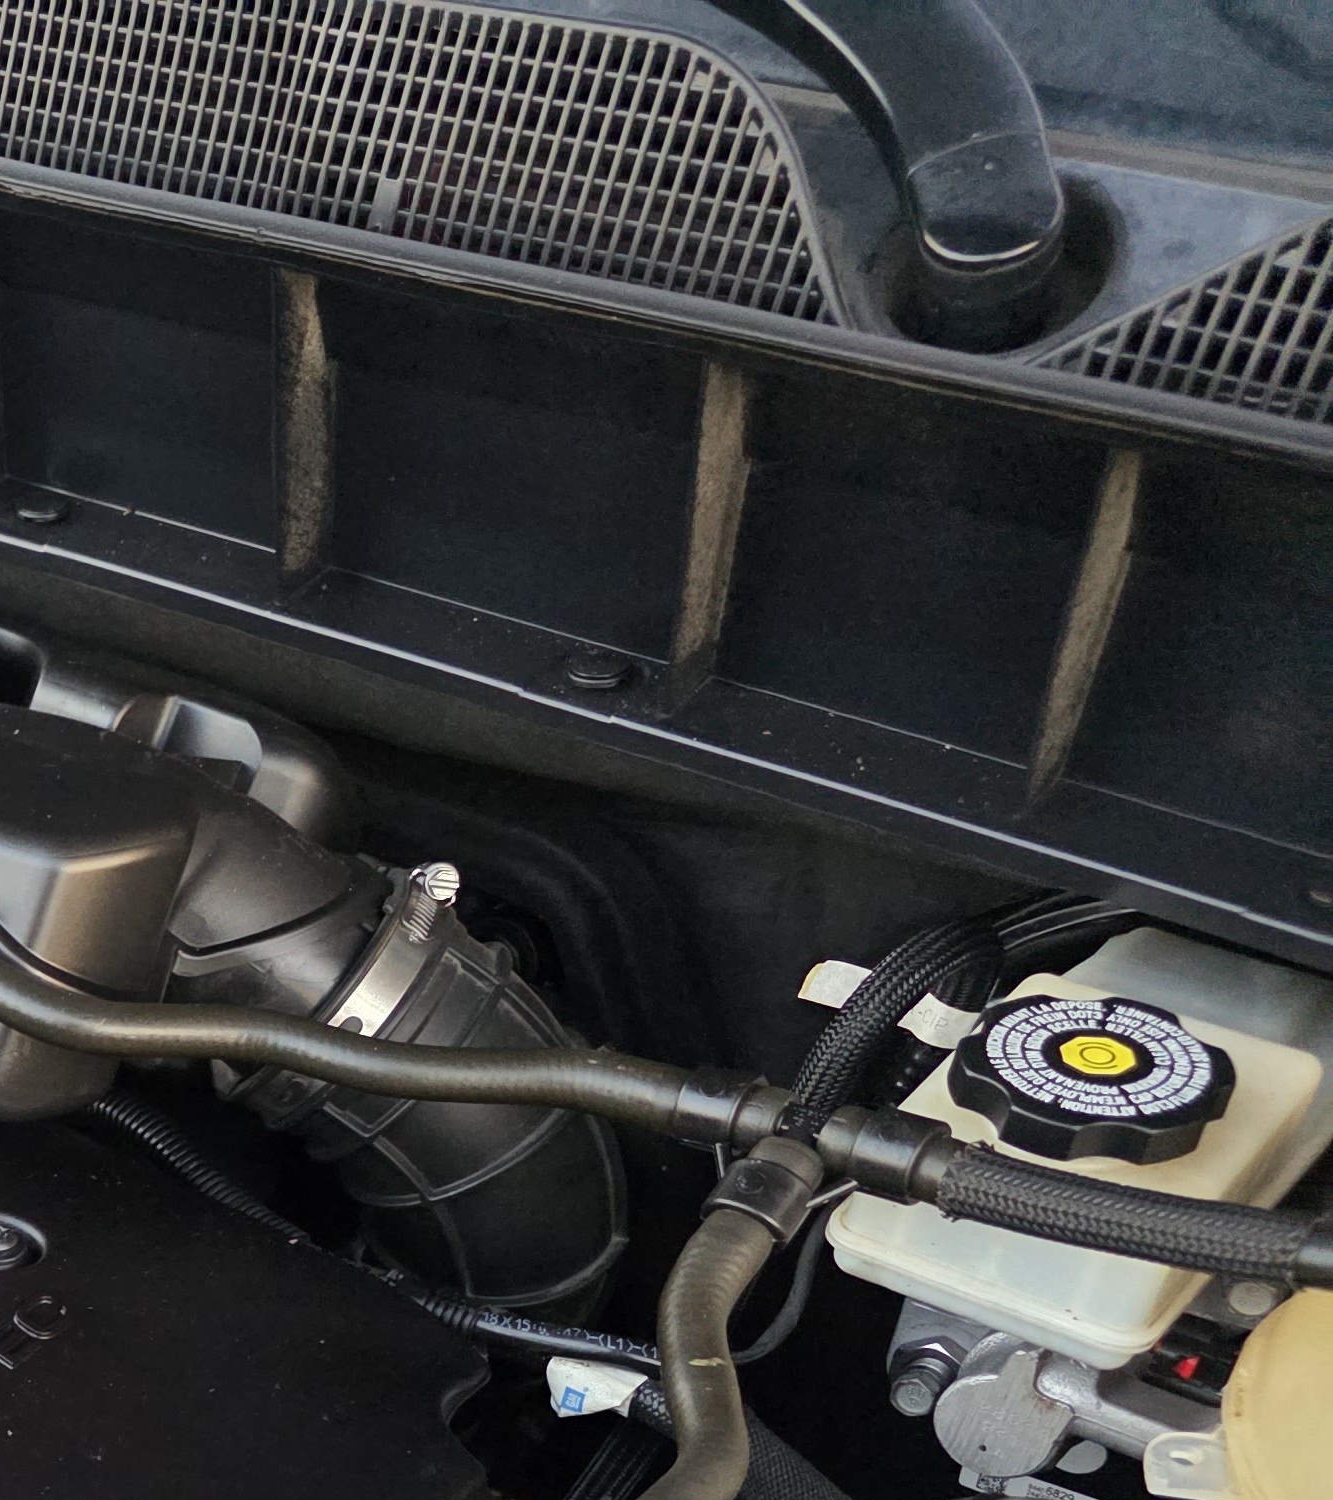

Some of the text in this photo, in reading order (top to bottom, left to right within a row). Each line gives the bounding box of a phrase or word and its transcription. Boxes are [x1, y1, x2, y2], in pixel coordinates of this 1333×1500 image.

[1027, 1002, 1053, 1014] LA
[1105, 1011, 1144, 1028] ONLY
[1138, 1022, 1170, 1039] USE
[988, 1058, 1010, 1069] LE
[996, 1068, 1056, 1103] NETTOYER
